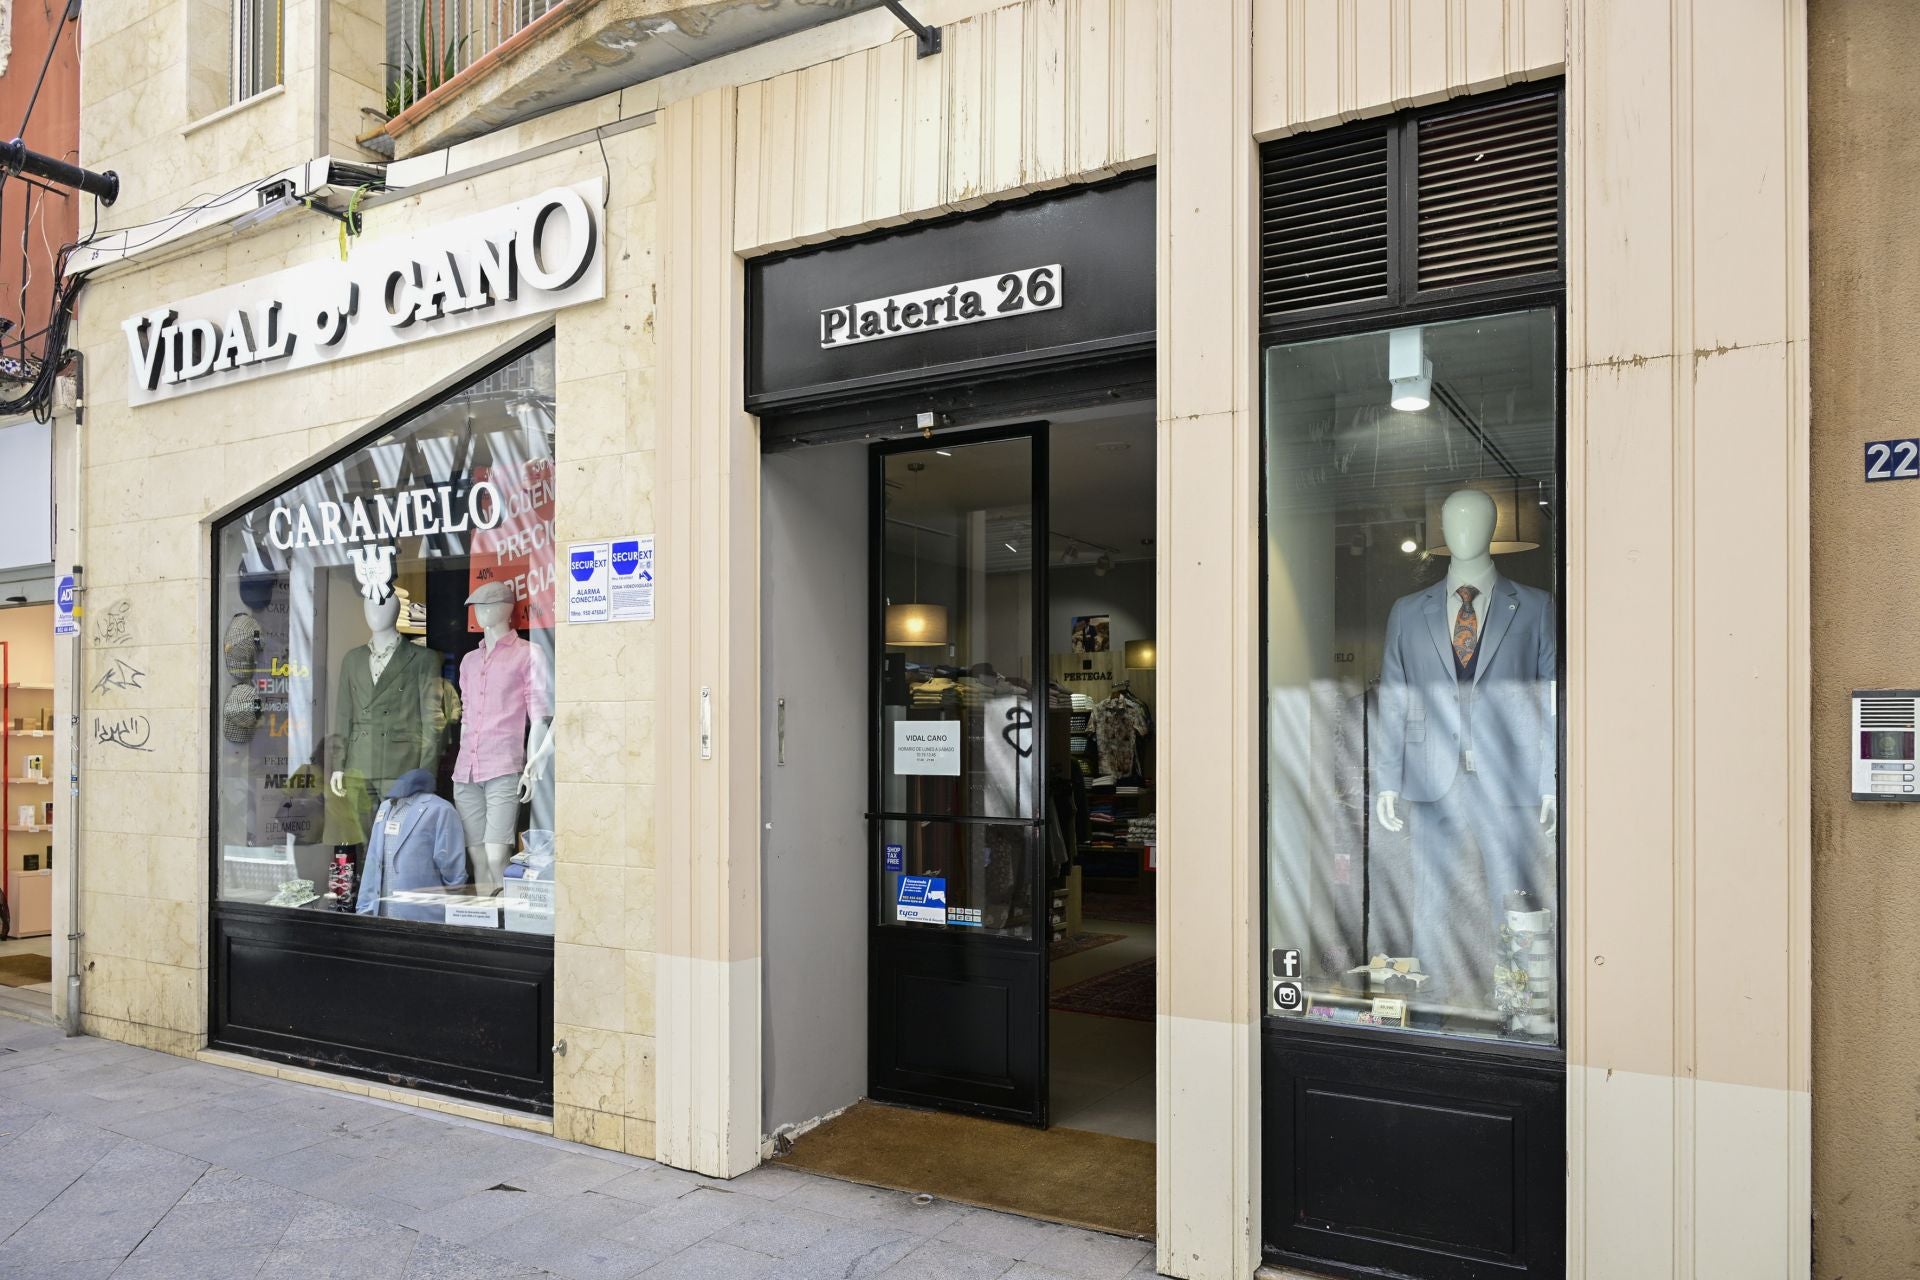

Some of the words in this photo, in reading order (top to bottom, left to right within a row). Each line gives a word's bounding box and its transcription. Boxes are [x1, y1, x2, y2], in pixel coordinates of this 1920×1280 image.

[122, 301, 296, 391] VIDAL
[384, 187, 597, 329] CANO
[820, 285, 986, 344] Platería
[996, 267, 1056, 312] 26
[1867, 441, 1918, 479] 22
[269, 482, 501, 550] CARAMELO
[496, 520, 556, 566] PRECI
[612, 550, 652, 562] SECUREXT
[571, 559, 607, 570] SECUREXT
[570, 595, 606, 604] CONECTADA
[577, 588, 601, 596] ALARMA
[271, 657, 310, 678] Lois
[1064, 671, 1112, 681] PERTEGAZ
[264, 773, 315, 789] MEYER
[899, 909, 918, 917] tyco
